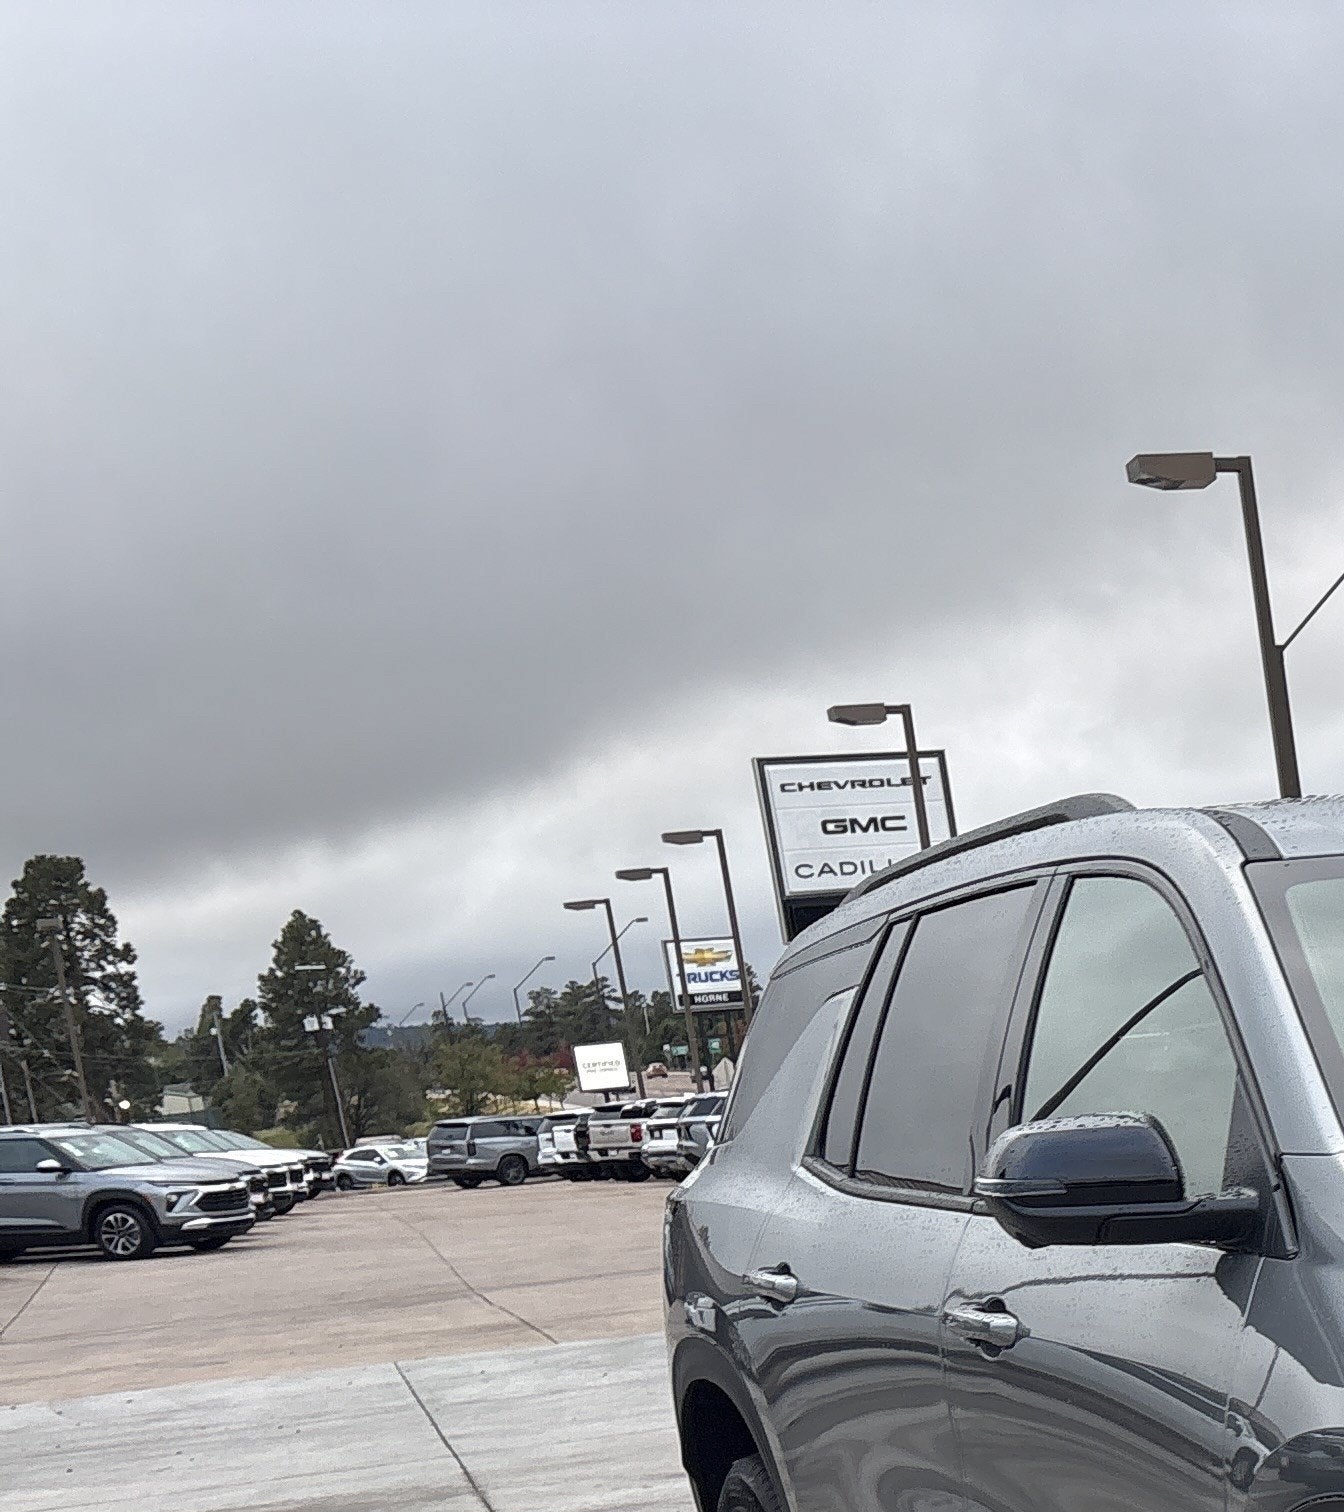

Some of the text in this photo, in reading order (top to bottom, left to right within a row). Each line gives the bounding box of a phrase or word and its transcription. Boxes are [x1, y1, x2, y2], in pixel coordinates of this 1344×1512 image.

[821, 815, 908, 835] GMC
[676, 968, 741, 984] RUCKS
[694, 993, 730, 1004] HORNE
